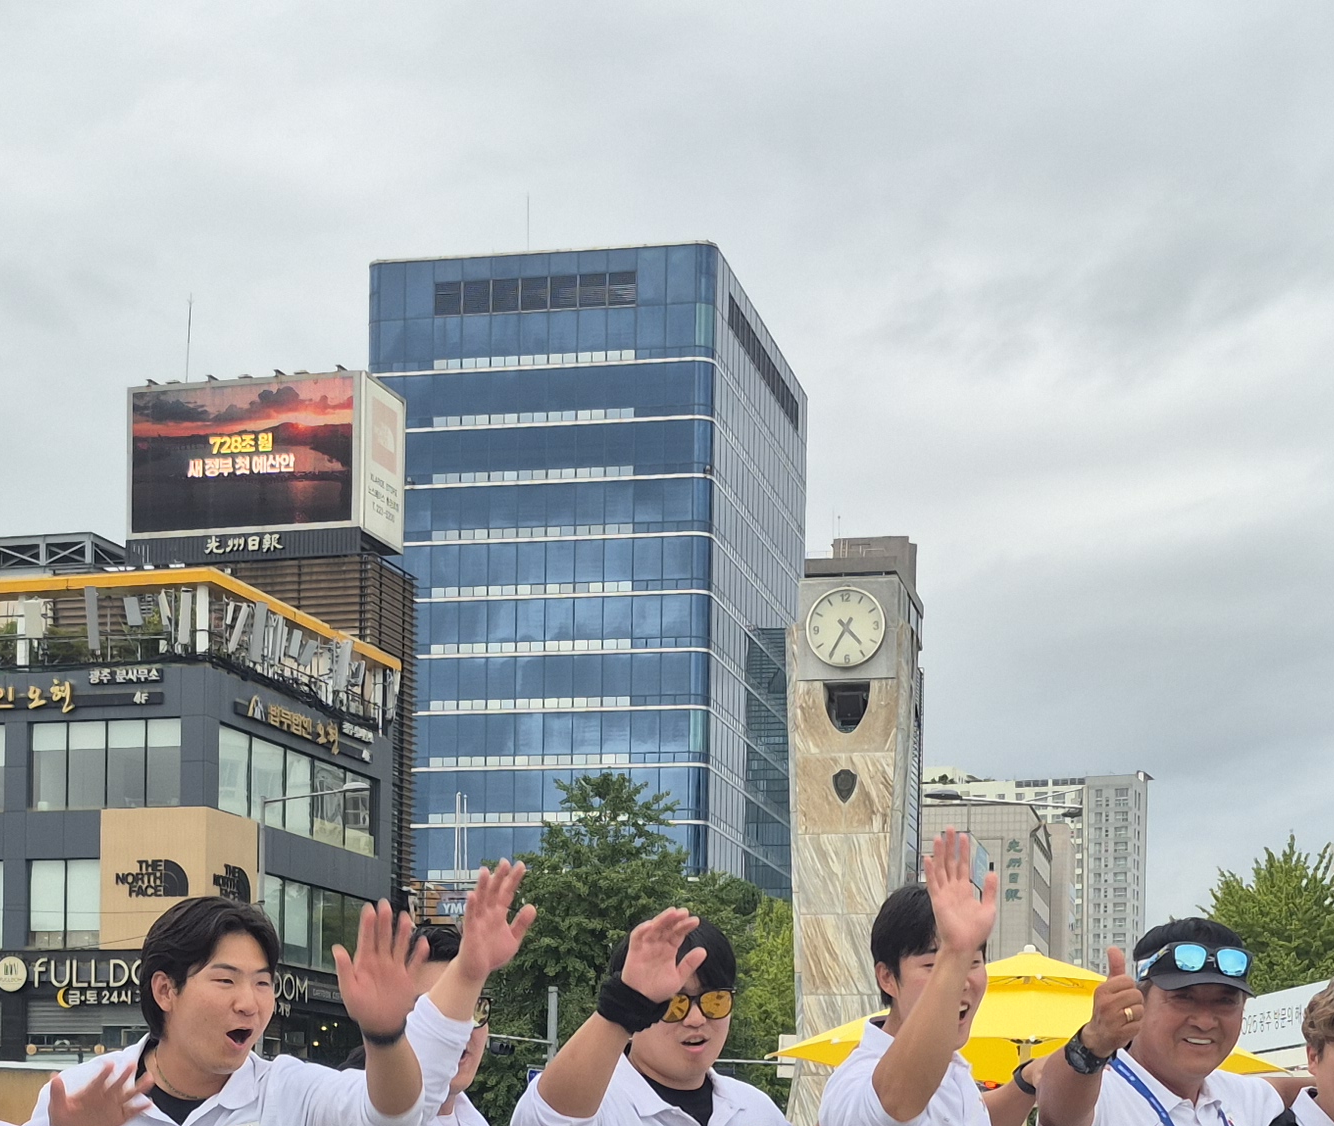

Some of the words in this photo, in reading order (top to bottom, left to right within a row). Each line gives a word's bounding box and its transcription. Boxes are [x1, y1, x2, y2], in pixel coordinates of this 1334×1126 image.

[209, 435, 256, 454] 728조
[258, 432, 273, 452] 원
[187, 459, 204, 478] 새
[205, 457, 233, 477] 정부
[252, 453, 295, 475] 예산안
[204, 533, 284, 555] 光州日報
[840, 592, 851, 603] 12
[813, 625, 820, 635] 9
[872, 621, 880, 631] 3
[843, 654, 851, 664] 6
[88, 669, 112, 684] 광주
[115, 668, 160, 683] 분사무소
[132, 690, 149, 705] 4F
[137, 859, 164, 872] THE
[223, 863, 240, 876] THE
[115, 872, 164, 885] NORTH
[128, 885, 164, 897] FACE
[101, 989, 132, 1005] 24시
[1241, 1014, 1258, 1036] 025
